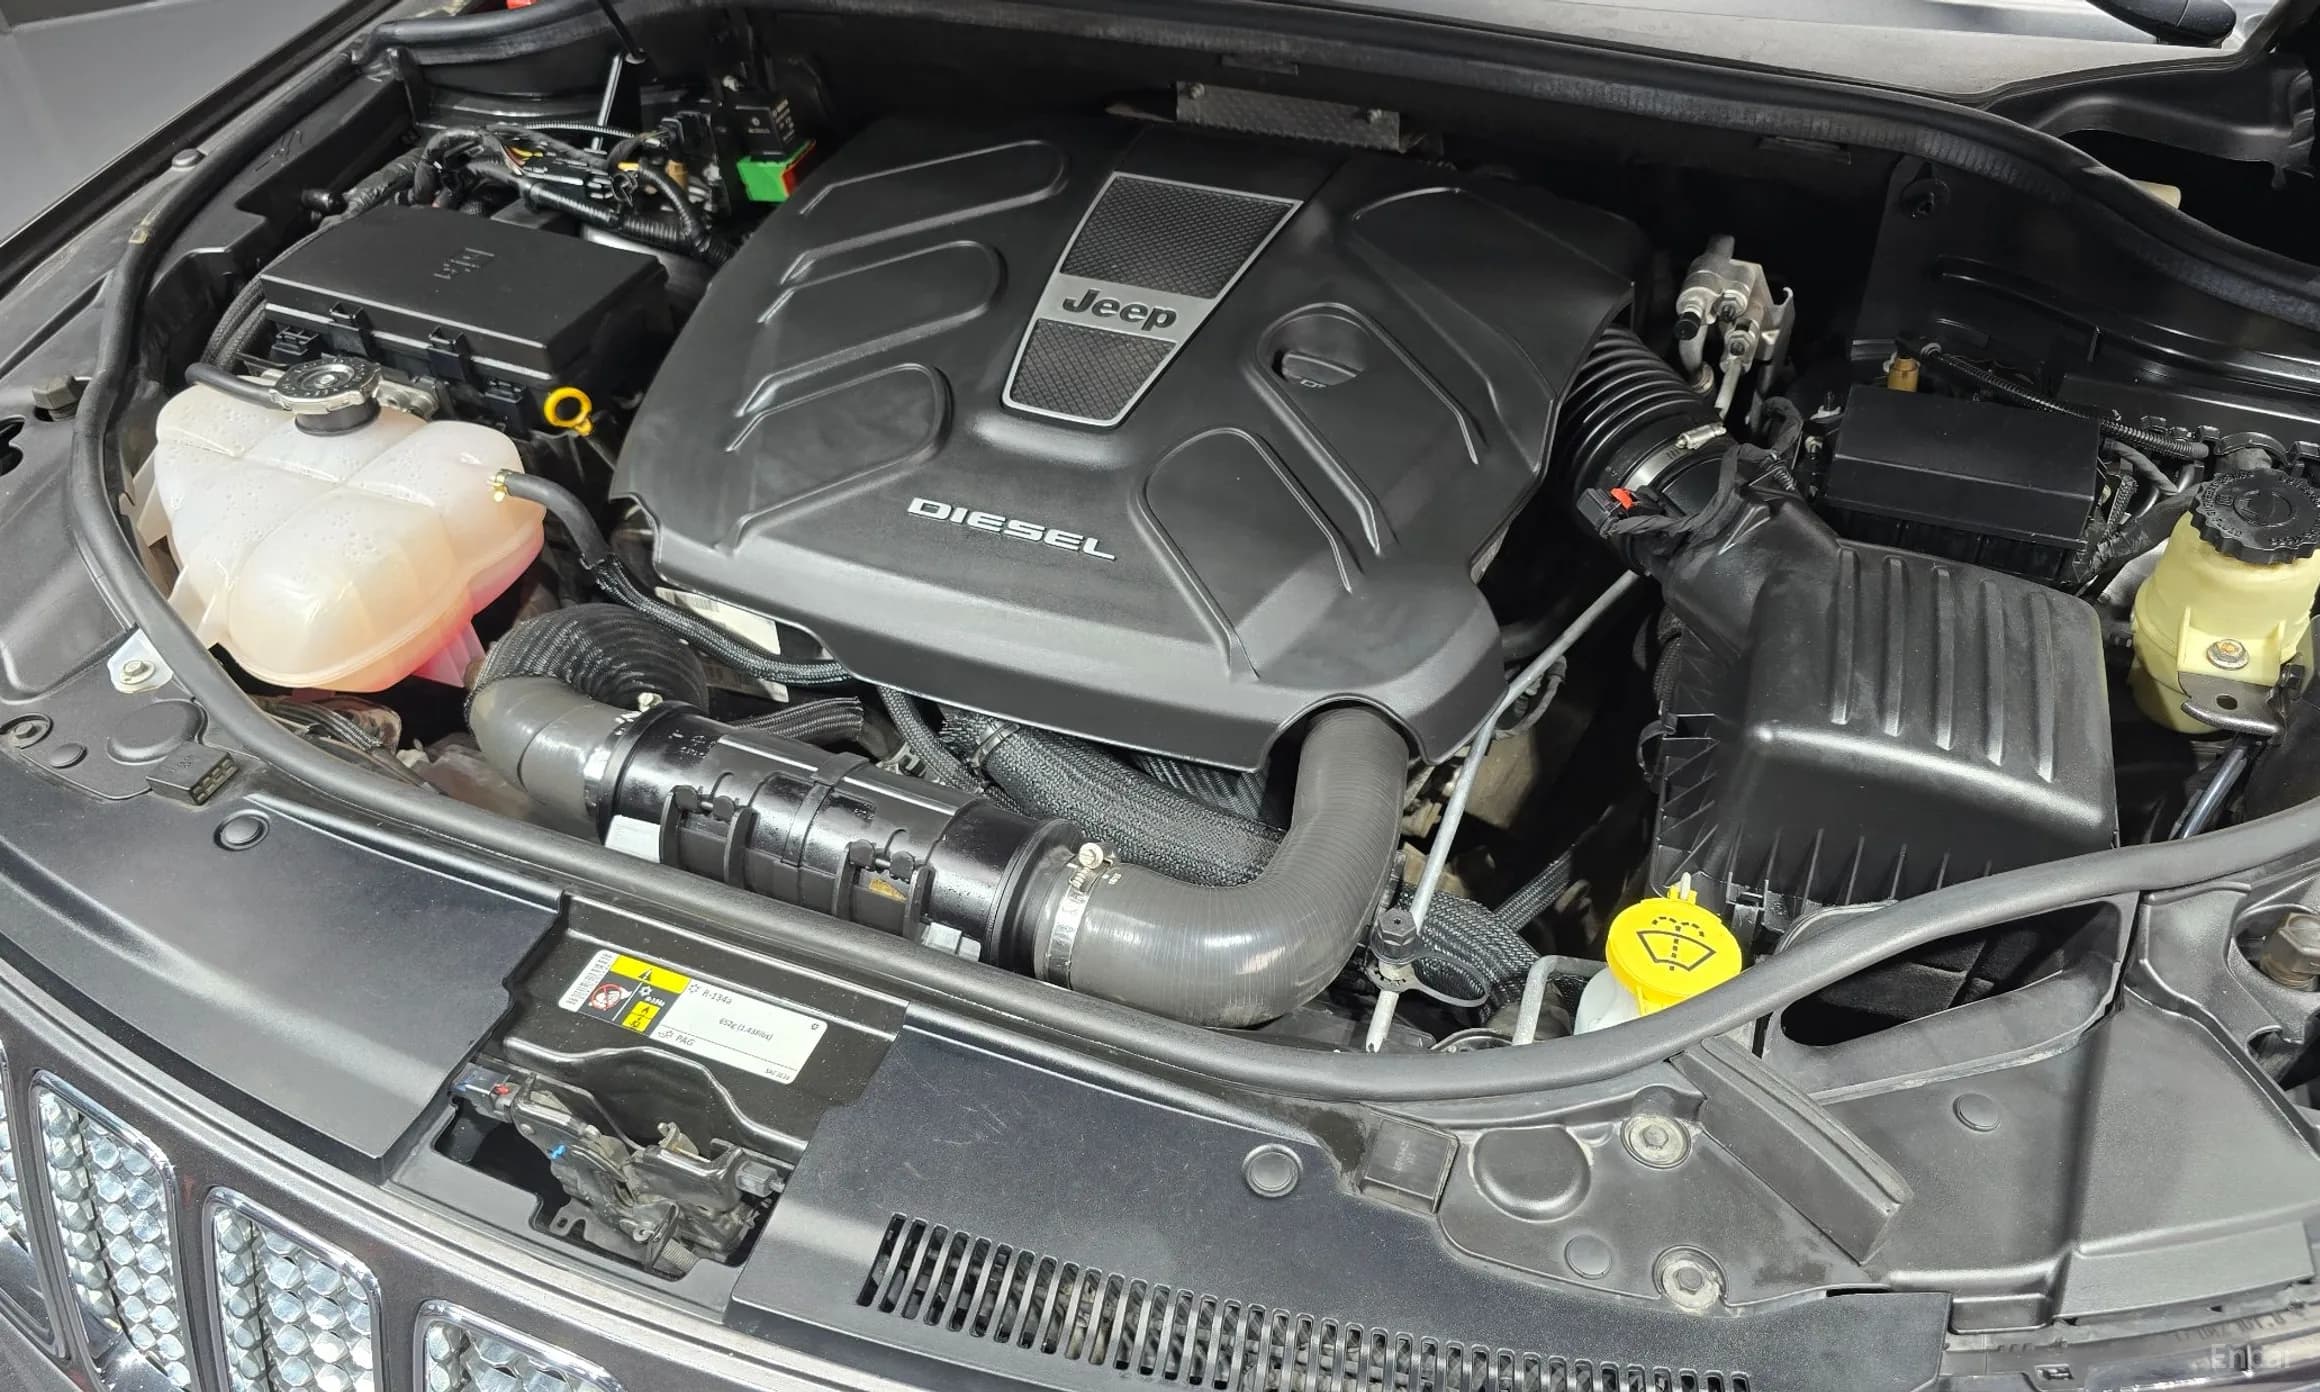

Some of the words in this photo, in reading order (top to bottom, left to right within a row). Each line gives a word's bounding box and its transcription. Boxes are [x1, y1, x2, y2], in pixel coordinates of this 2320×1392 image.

[1062, 287, 1178, 332] Jeep
[907, 496, 1116, 562] DIESEL
[675, 1034, 694, 1047] PAG
